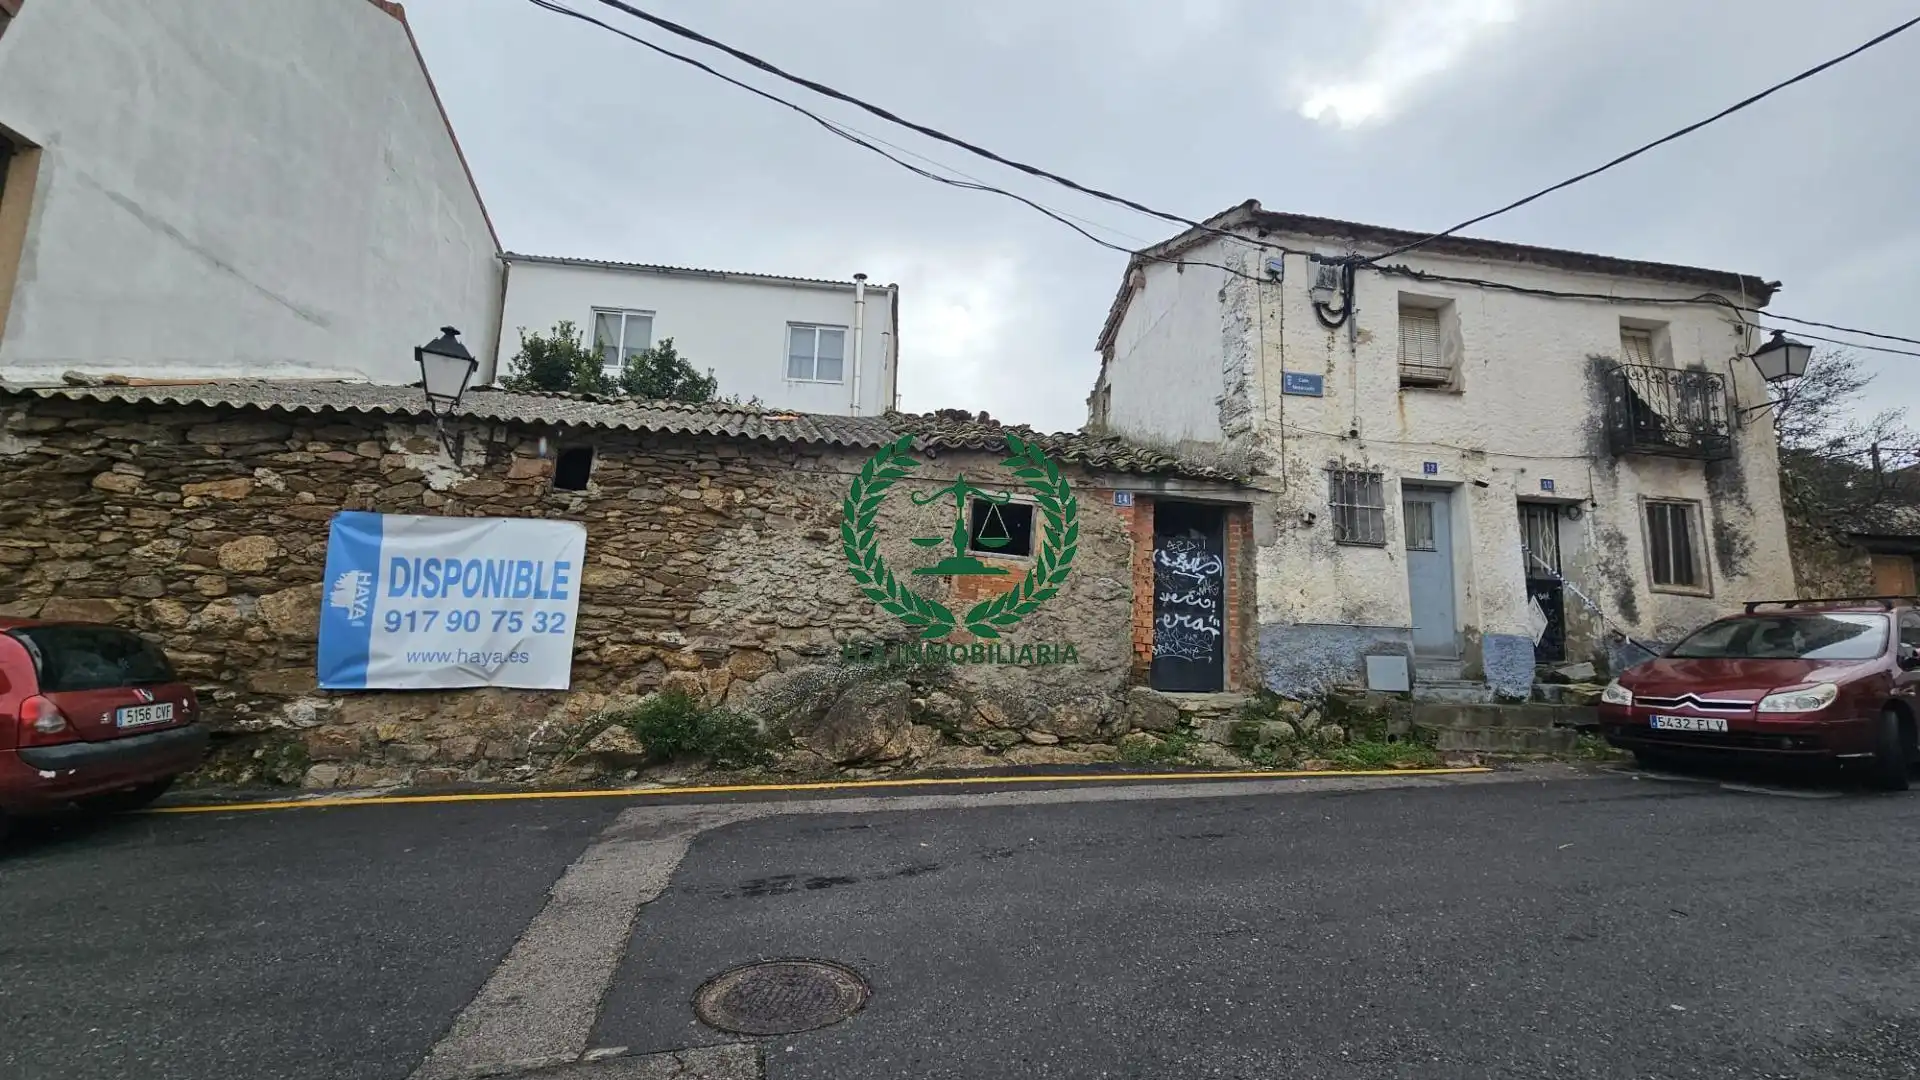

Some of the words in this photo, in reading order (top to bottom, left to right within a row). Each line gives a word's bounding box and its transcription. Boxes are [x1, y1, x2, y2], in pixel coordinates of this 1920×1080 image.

[388, 556, 571, 600] DISPONIBLE
[352, 571, 373, 620] HAYA
[384, 609, 440, 633] 917
[446, 609, 481, 633] 90
[491, 610, 524, 634] 75
[531, 612, 566, 634] 32
[406, 648, 530, 665] www.haya.es
[127, 708, 151, 723] 5156
[155, 704, 172, 719] CVF
[1657, 716, 1692, 729] 5432
[1697, 719, 1724, 732] FLV
